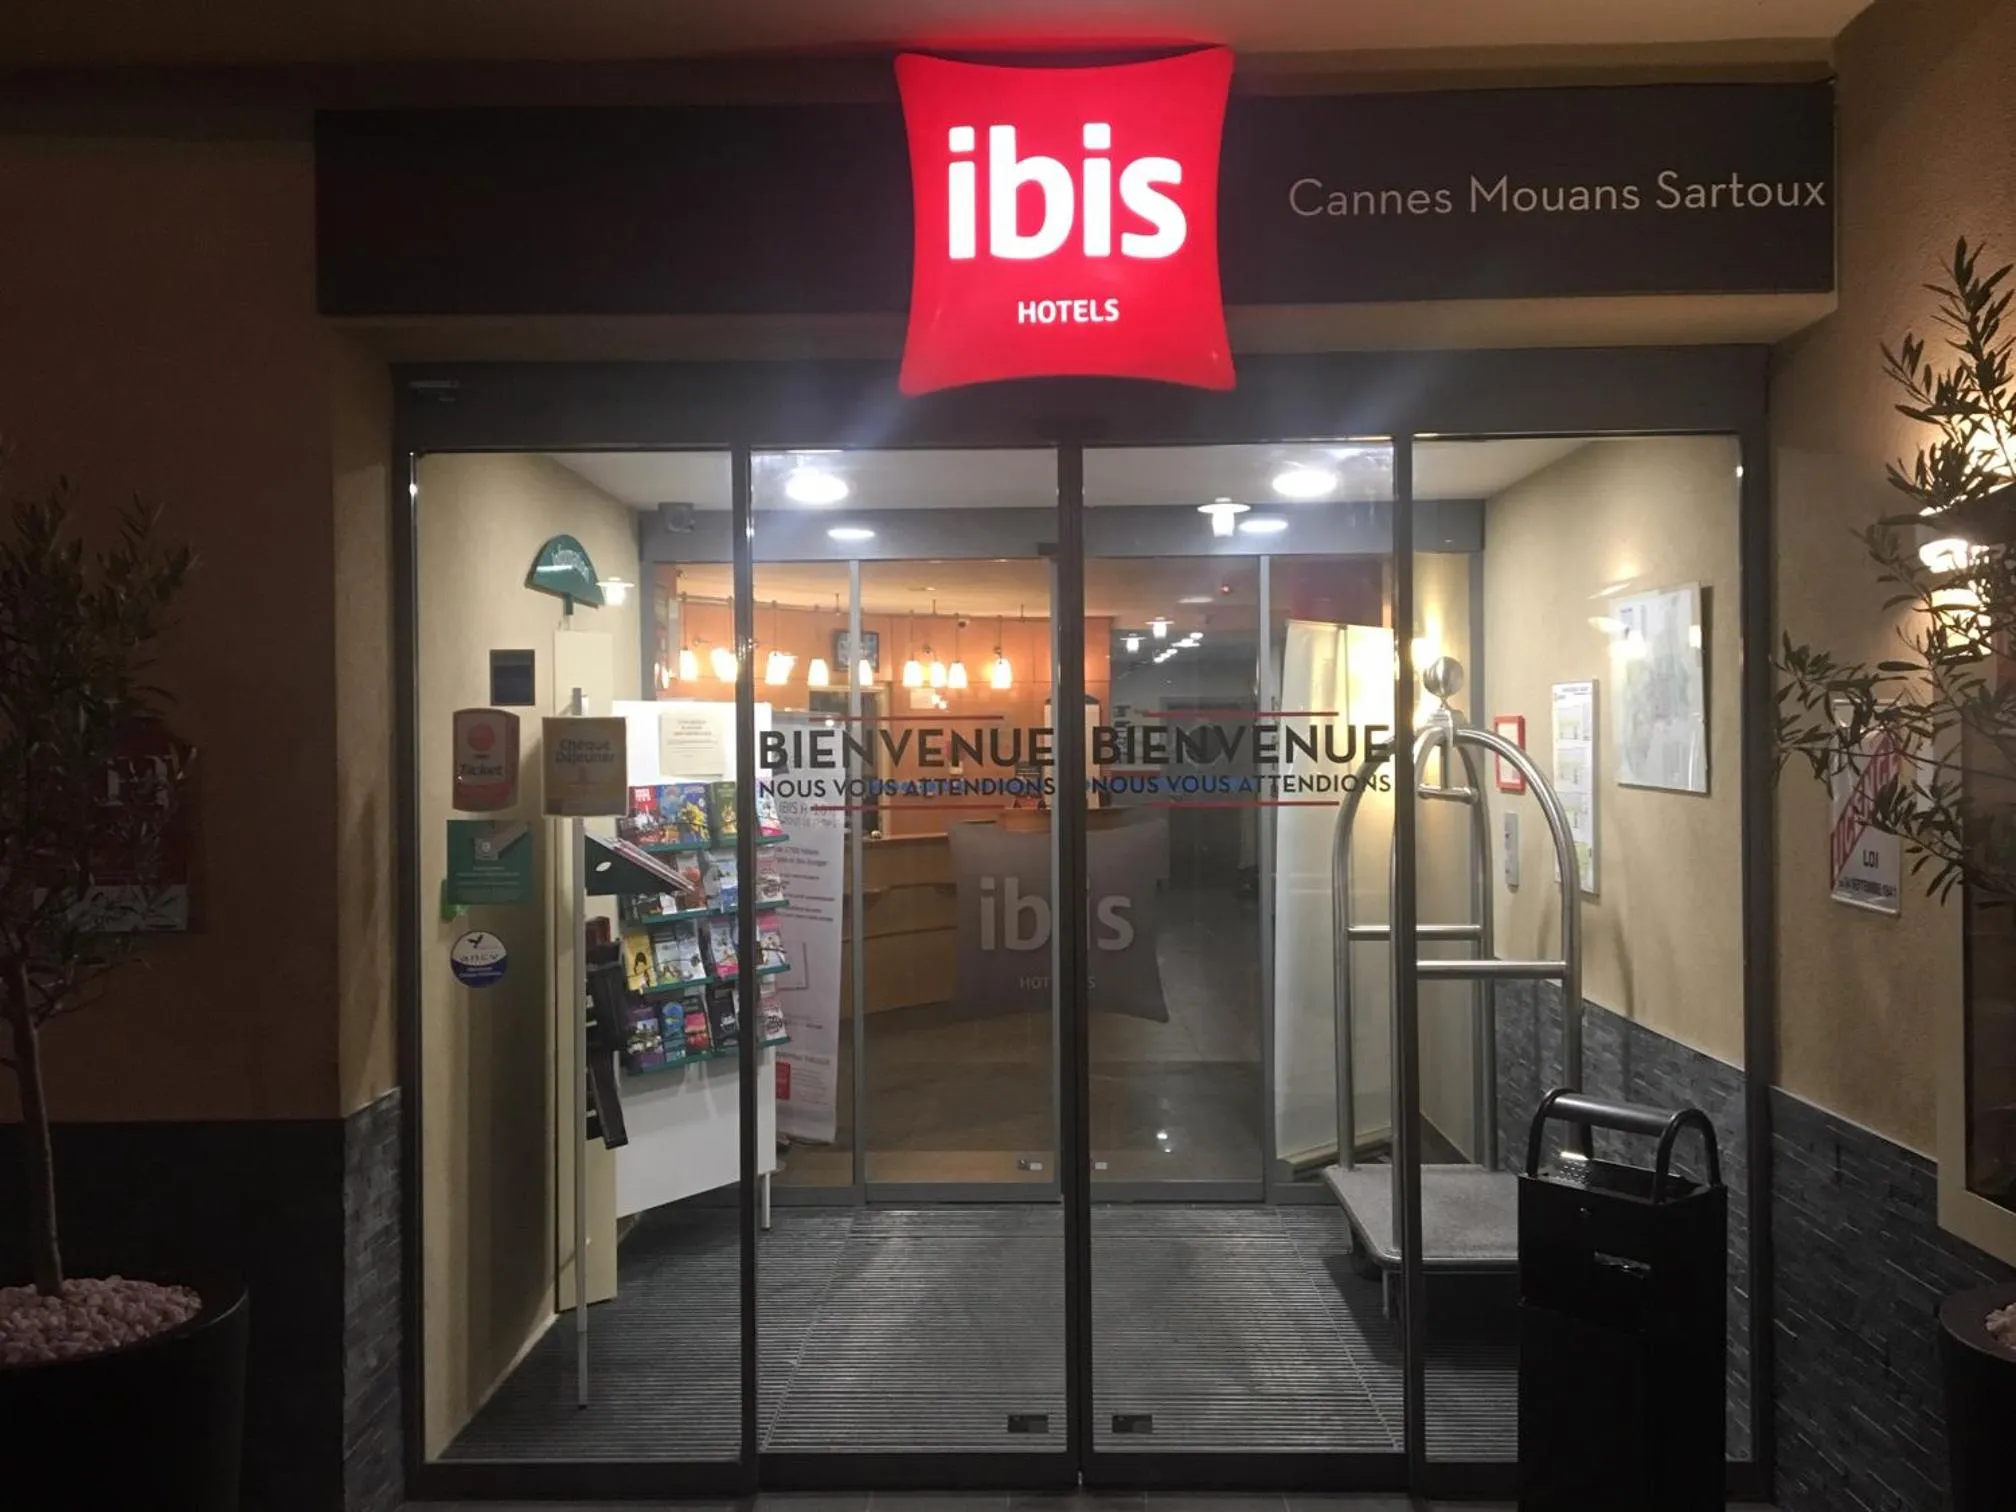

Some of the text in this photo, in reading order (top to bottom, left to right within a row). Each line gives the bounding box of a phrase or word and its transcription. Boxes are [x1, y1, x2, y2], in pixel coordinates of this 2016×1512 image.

[948, 122, 1187, 260] ibis
[1289, 170, 1826, 217] Cannes Mouans Sartoux
[1017, 298, 1120, 324] HOTELS
[759, 728, 1055, 769] BIENVENUE
[1092, 725, 1391, 765] BIENVENUE
[759, 777, 1056, 798] NOUS VOUS ATTENDIONS
[1092, 774, 1392, 794] NOUS VOUS ATTENDIONS
[981, 876, 1135, 951] ibs
[1020, 976, 1097, 990] HOTS
